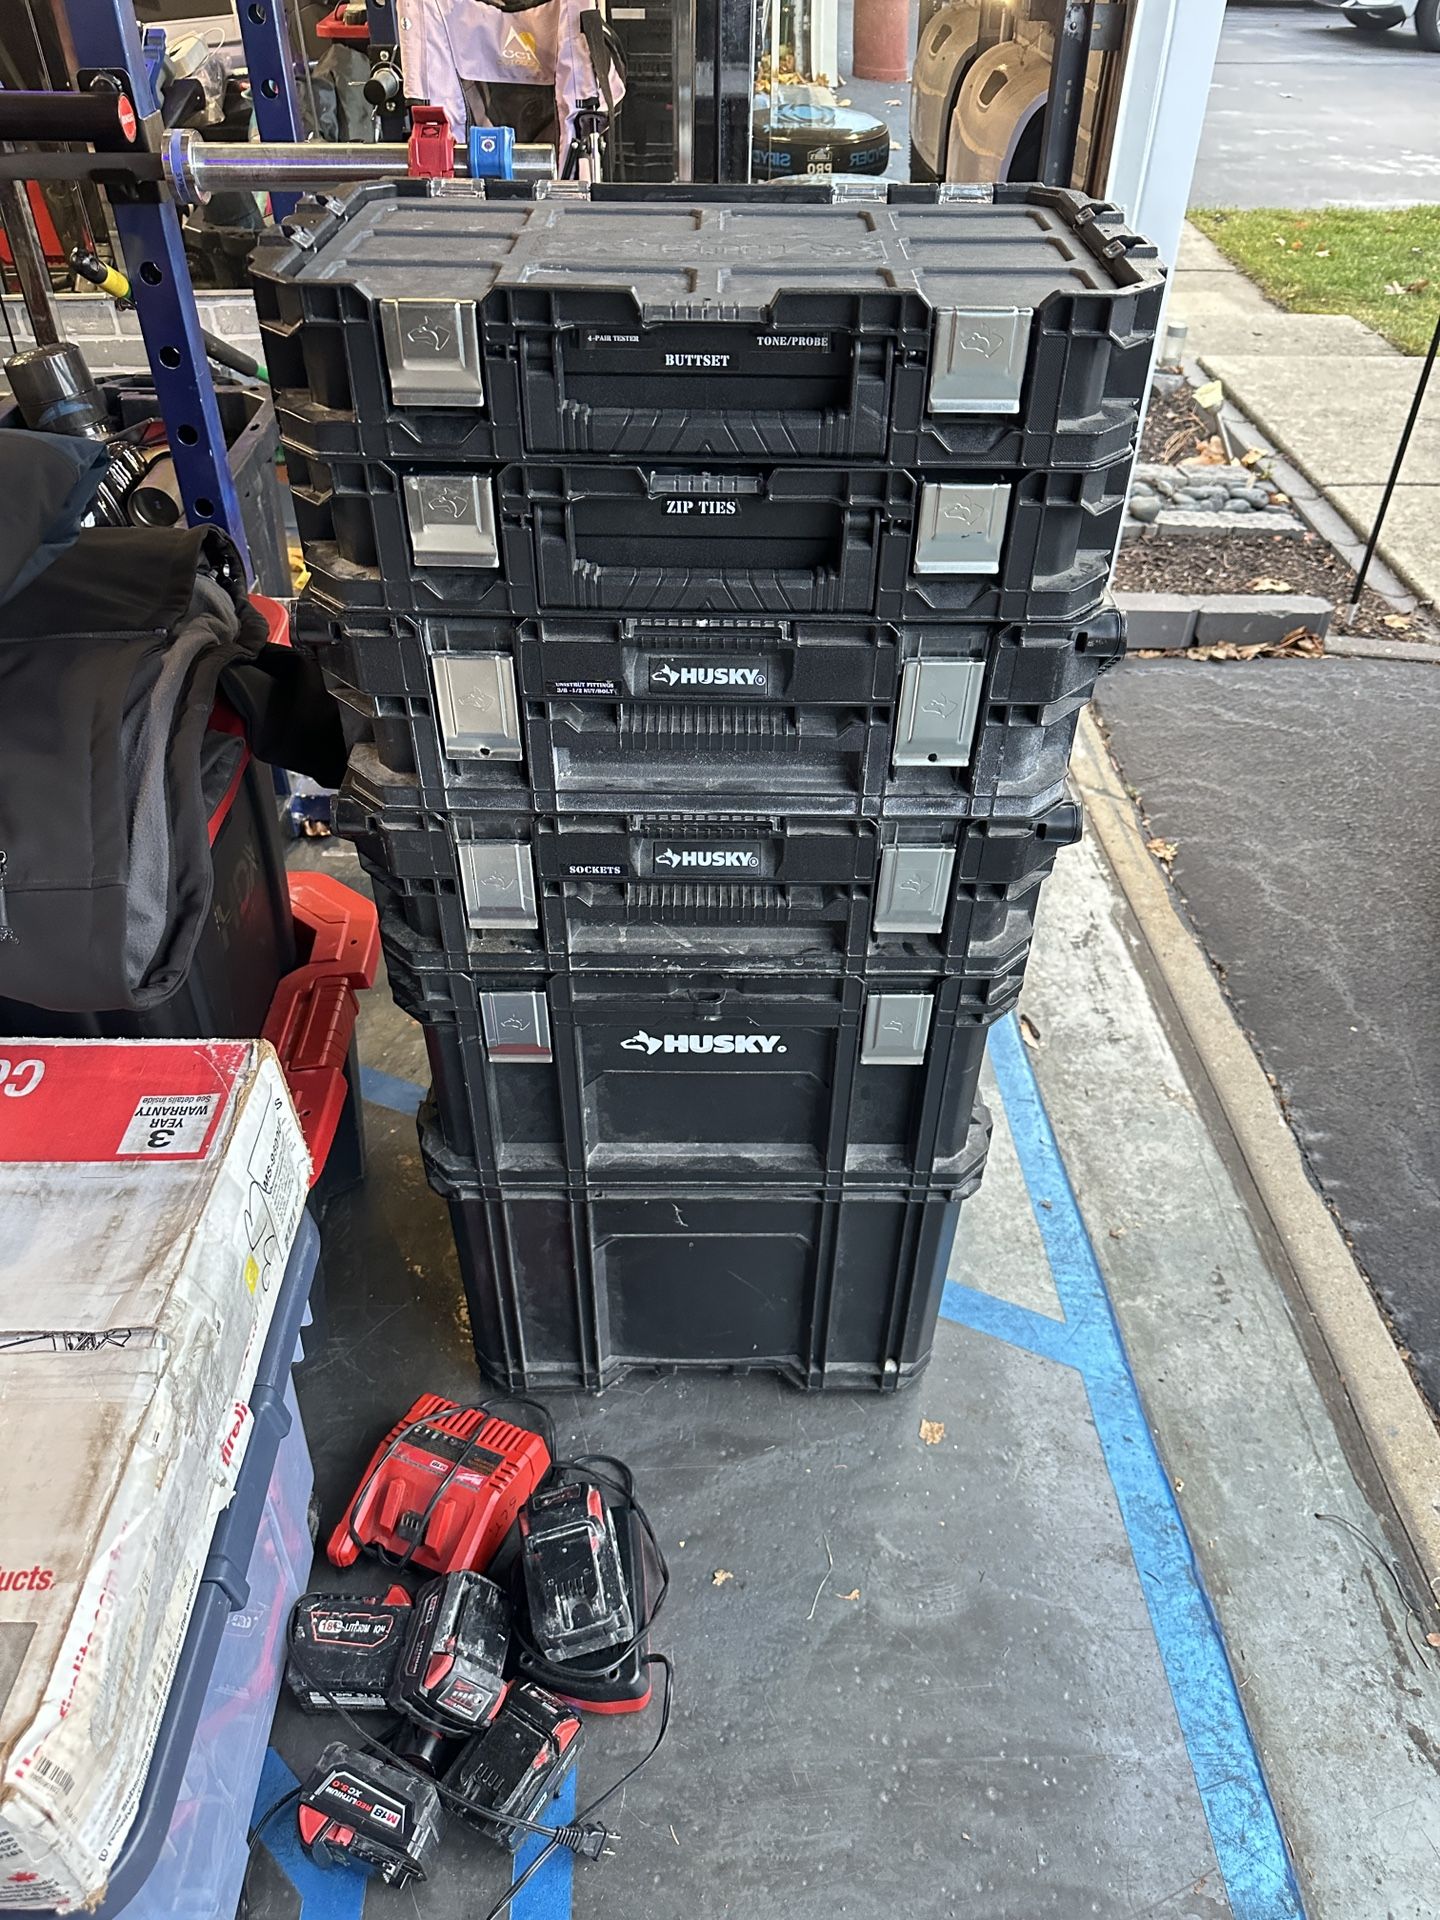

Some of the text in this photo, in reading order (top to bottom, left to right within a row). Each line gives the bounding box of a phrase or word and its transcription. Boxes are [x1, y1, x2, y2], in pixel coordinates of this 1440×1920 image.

[587, 334, 640, 342] 4-PAIR TESTER
[757, 336, 829, 347] TONE/PROBE
[665, 353, 730, 366] BUTTSET
[666, 500, 736, 515] ZIP TIES
[569, 865, 621, 875] SOCKETS
[663, 1034, 781, 1054] HUSKY
[167, 1096, 195, 1104] details
[196, 1095, 212, 1103] See
[134, 1105, 208, 1117] WARRANTY
[149, 1117, 184, 1129] YEAR
[147, 1129, 176, 1149] 3
[0, 1565, 53, 1591] ucts
[331, 1779, 363, 1798] XC5.0
[324, 1786, 373, 1812] REDLITHIUM
[373, 1806, 399, 1825] M18
